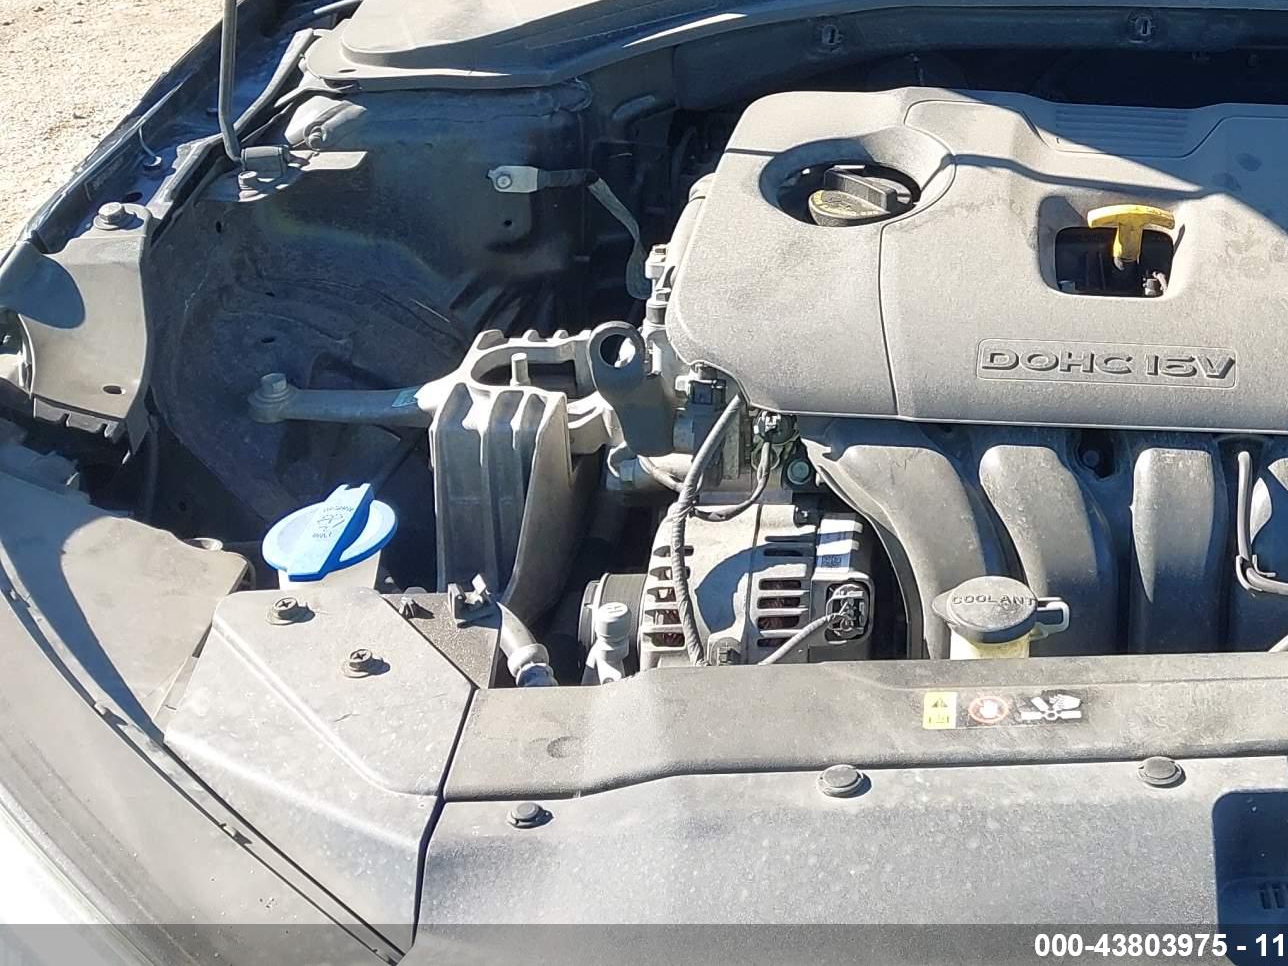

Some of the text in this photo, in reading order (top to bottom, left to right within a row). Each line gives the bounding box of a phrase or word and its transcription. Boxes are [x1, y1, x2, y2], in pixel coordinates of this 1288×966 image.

[982, 349, 1236, 379] DOHC 16V
[952, 594, 1036, 606] COOLANT
